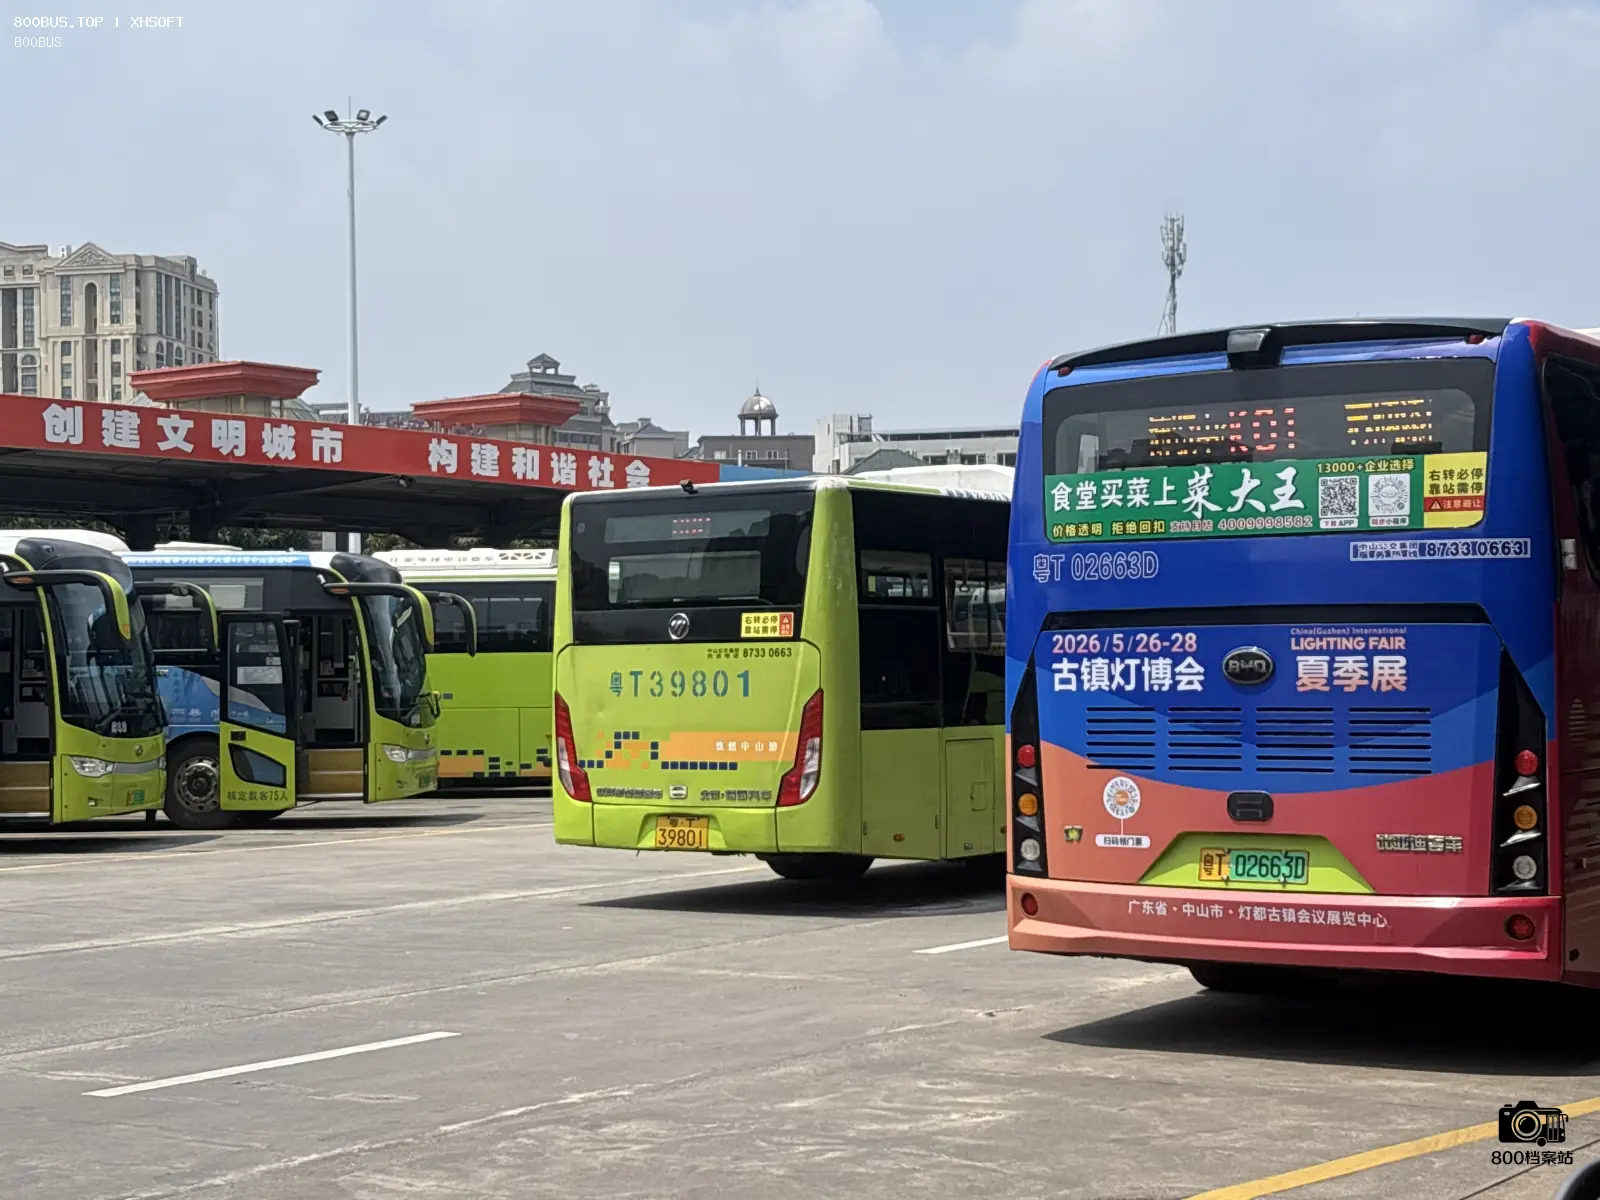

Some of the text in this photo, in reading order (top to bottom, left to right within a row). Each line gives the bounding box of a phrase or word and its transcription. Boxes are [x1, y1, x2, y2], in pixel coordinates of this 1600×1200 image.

[42, 403, 650, 488] 创建文明城市 构建和谐社会
[1317, 459, 1415, 473] 13000+企业选择
[1429, 468, 1484, 481] 右转必停
[1051, 466, 1305, 520] 食堂买菜上 菜大王
[1429, 483, 1484, 495] 靠站需停
[1052, 523, 1103, 538] 价格透明
[1111, 519, 1166, 535] 拒绝回扣
[1217, 515, 1314, 531] 4009998582
[1426, 542, 1472, 557] 8733
[1071, 551, 1159, 581] 02663D
[744, 615, 778, 624] 右转必停
[743, 647, 792, 658] 8733 0663
[1290, 636, 1406, 651] LIGHTING FAIR
[1051, 656, 1205, 692] 古镇灯博会
[1296, 655, 1408, 692] 夏季展
[658, 829, 703, 847] 39801
[1235, 853, 1306, 879] 02663D
